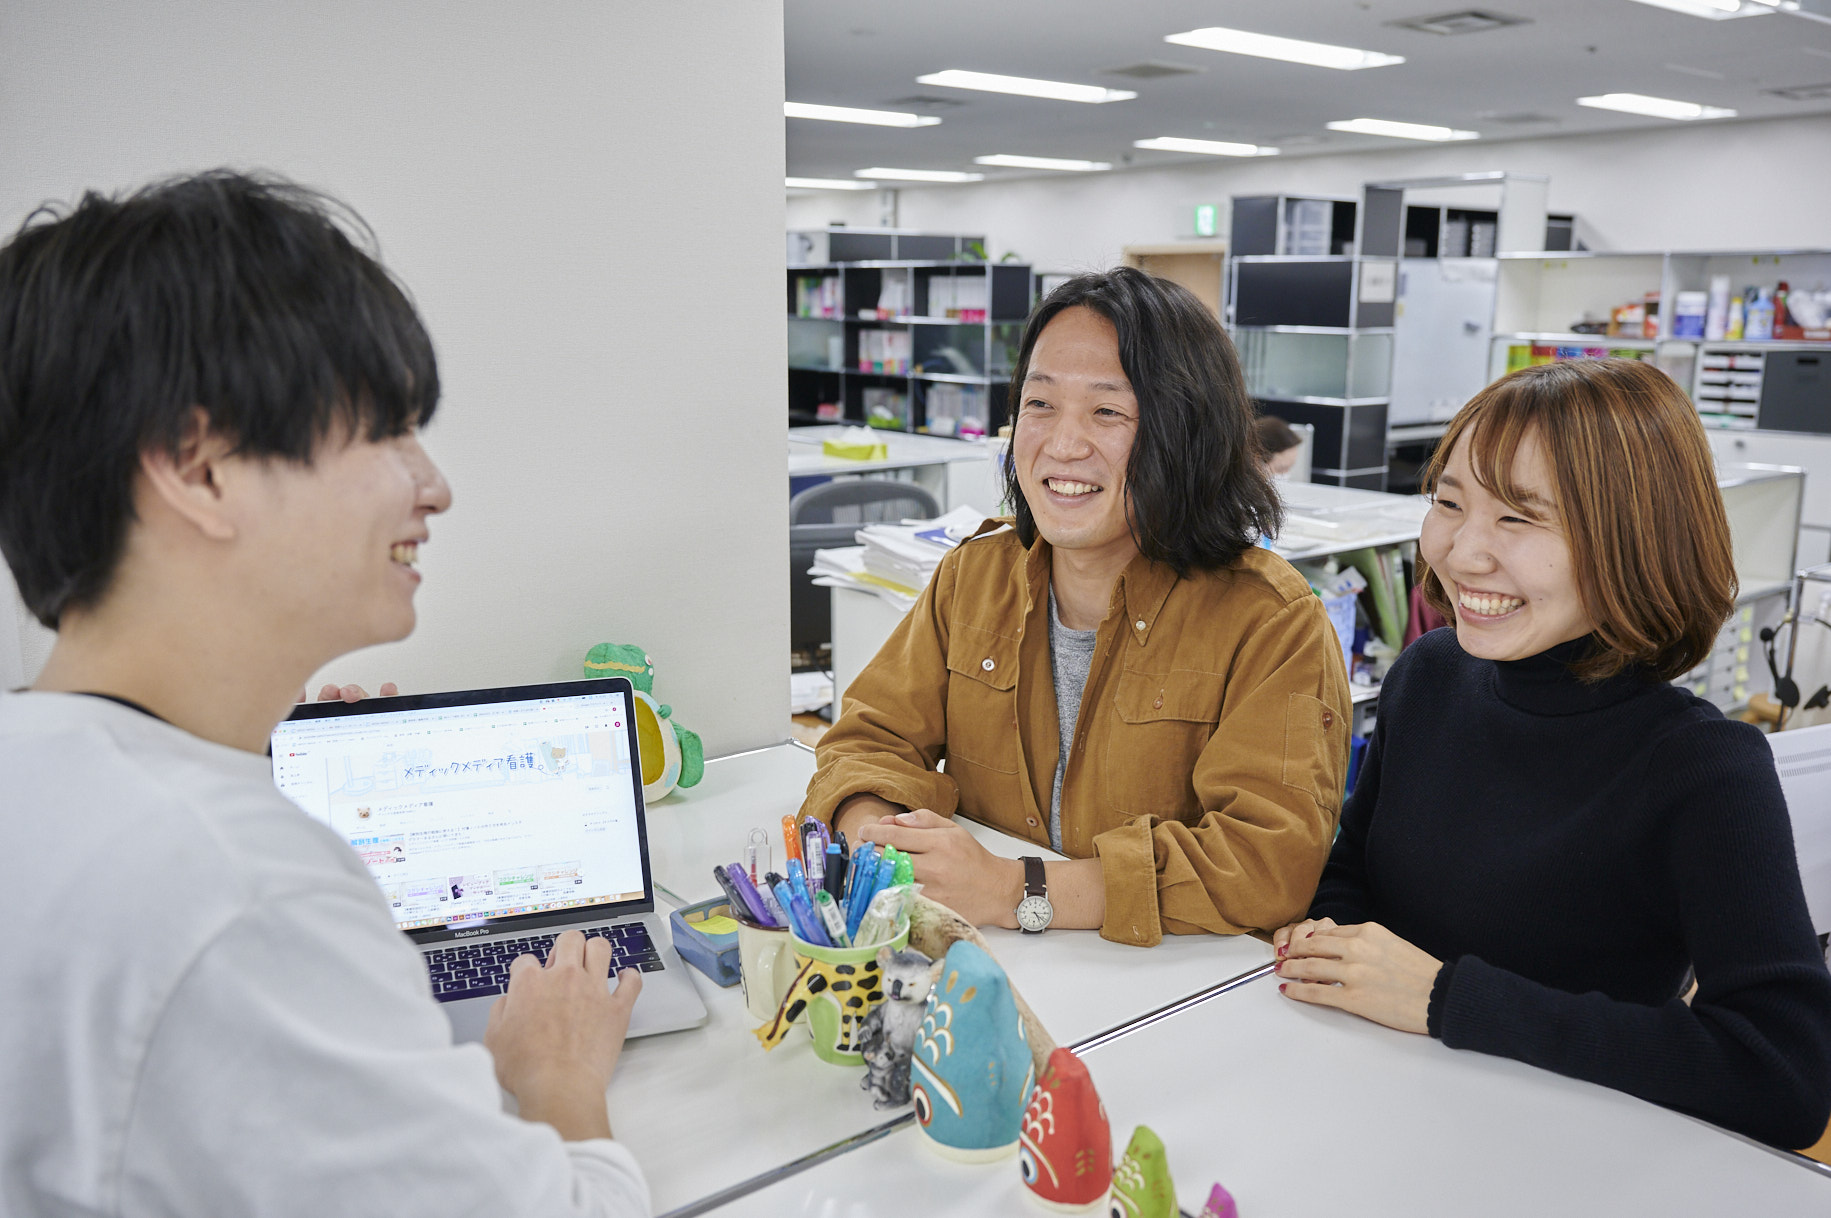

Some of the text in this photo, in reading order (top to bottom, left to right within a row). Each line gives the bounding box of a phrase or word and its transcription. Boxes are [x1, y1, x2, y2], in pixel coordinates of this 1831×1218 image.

[404, 752, 534, 778] メディックメディア看護
[454, 930, 480, 938] MacBook
